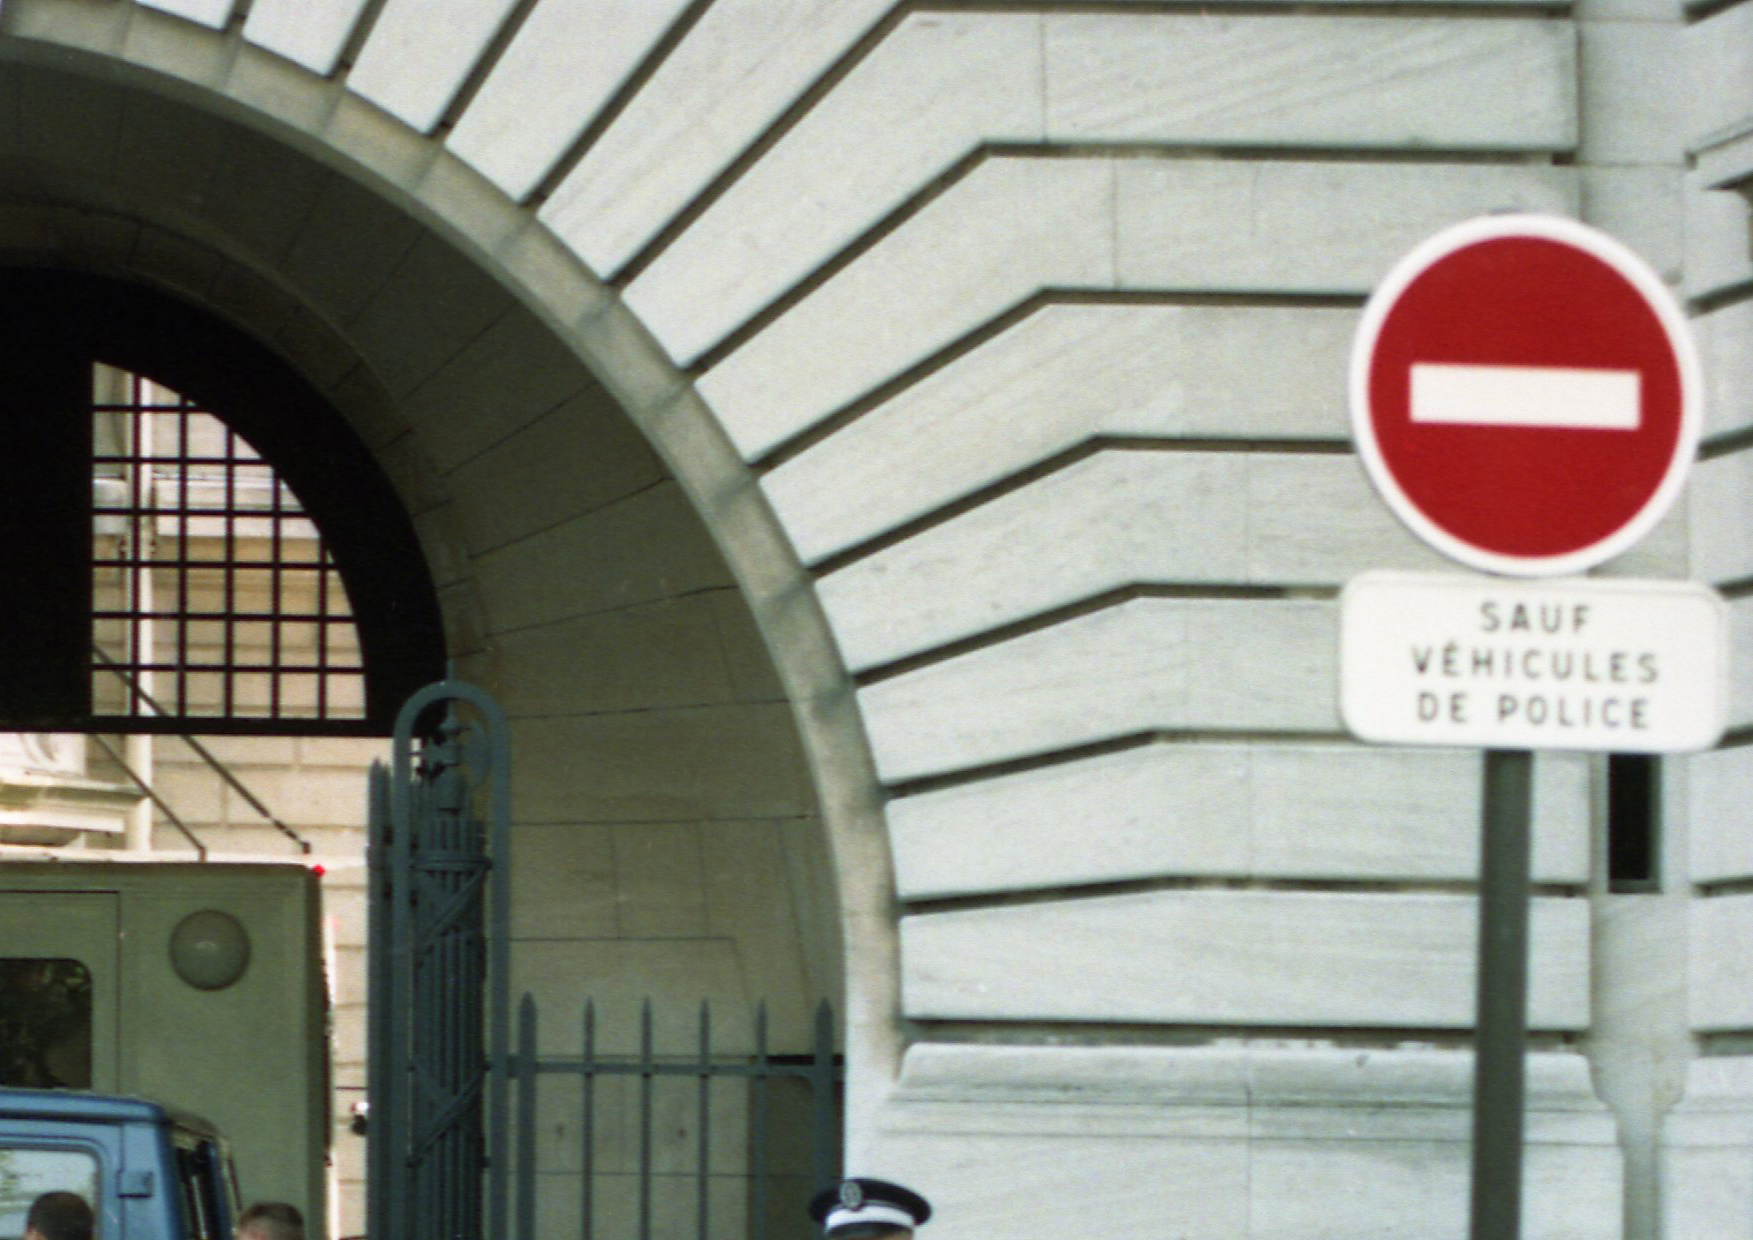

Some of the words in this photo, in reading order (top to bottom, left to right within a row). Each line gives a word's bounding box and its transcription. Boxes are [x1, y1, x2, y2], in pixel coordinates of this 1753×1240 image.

[1480, 602, 1593, 632] SAUF
[1411, 641, 1659, 684] VÉHICULES
[1417, 691, 1467, 723] DE
[1497, 693, 1649, 729] POLICE
